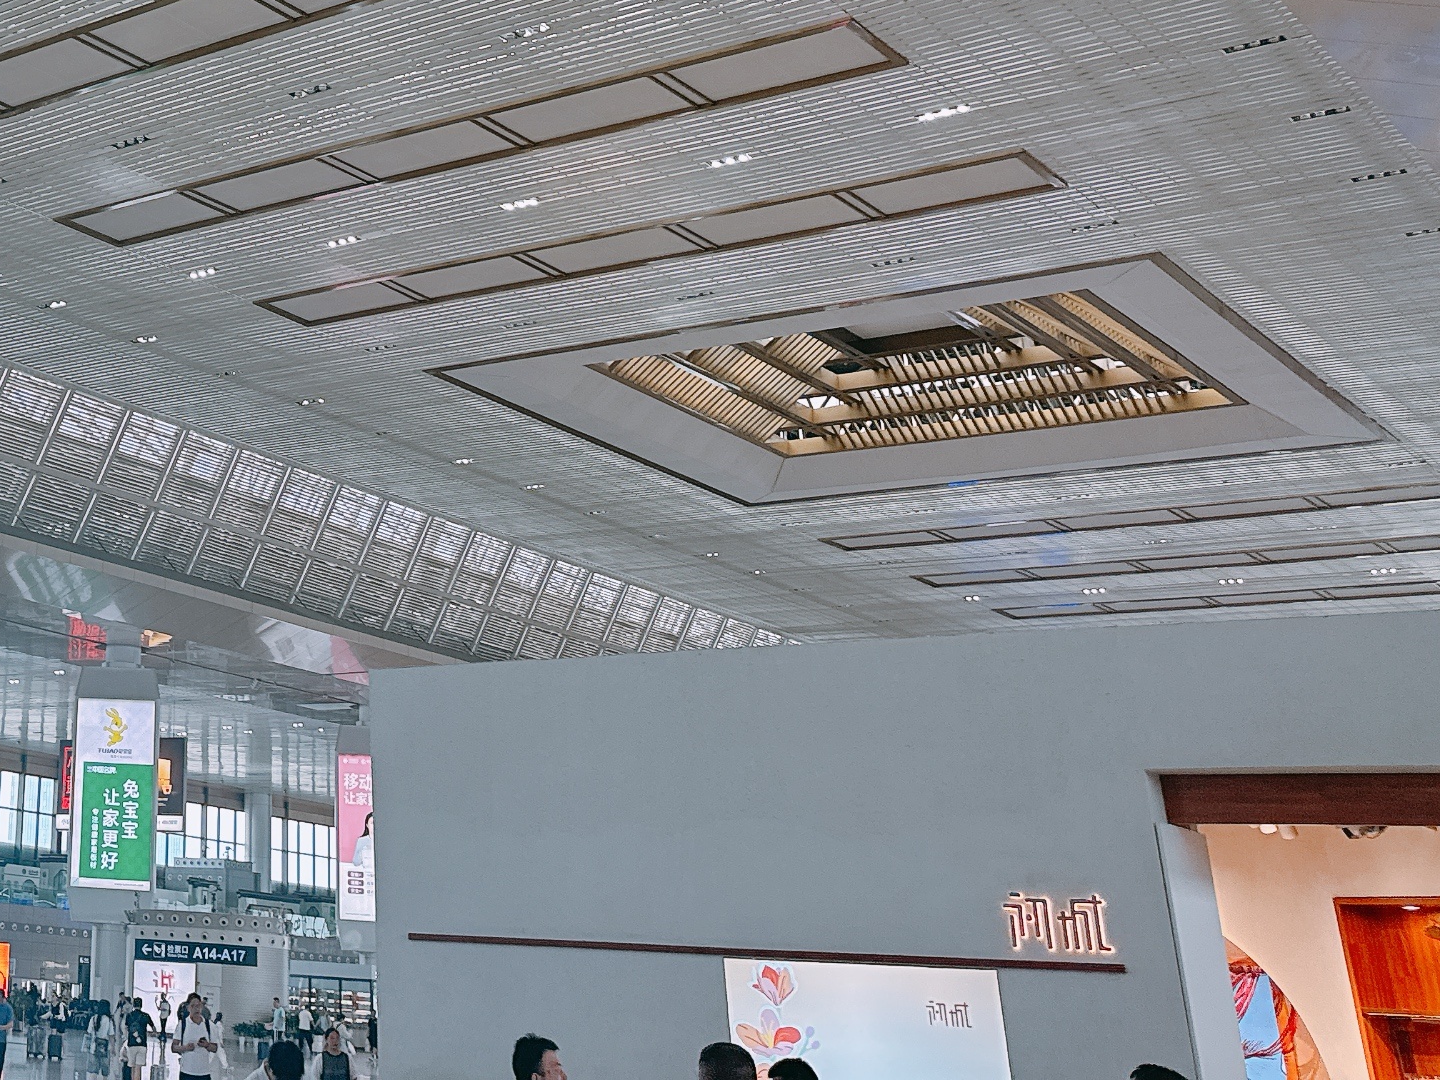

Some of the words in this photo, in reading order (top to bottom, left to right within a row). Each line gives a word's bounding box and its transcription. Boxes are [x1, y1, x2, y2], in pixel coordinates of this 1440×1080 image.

[100, 787, 121, 871] 让家更好
[121, 778, 140, 840] 兔宝宝
[167, 944, 189, 954] 检票口
[192, 946, 247, 962] A14-A17
